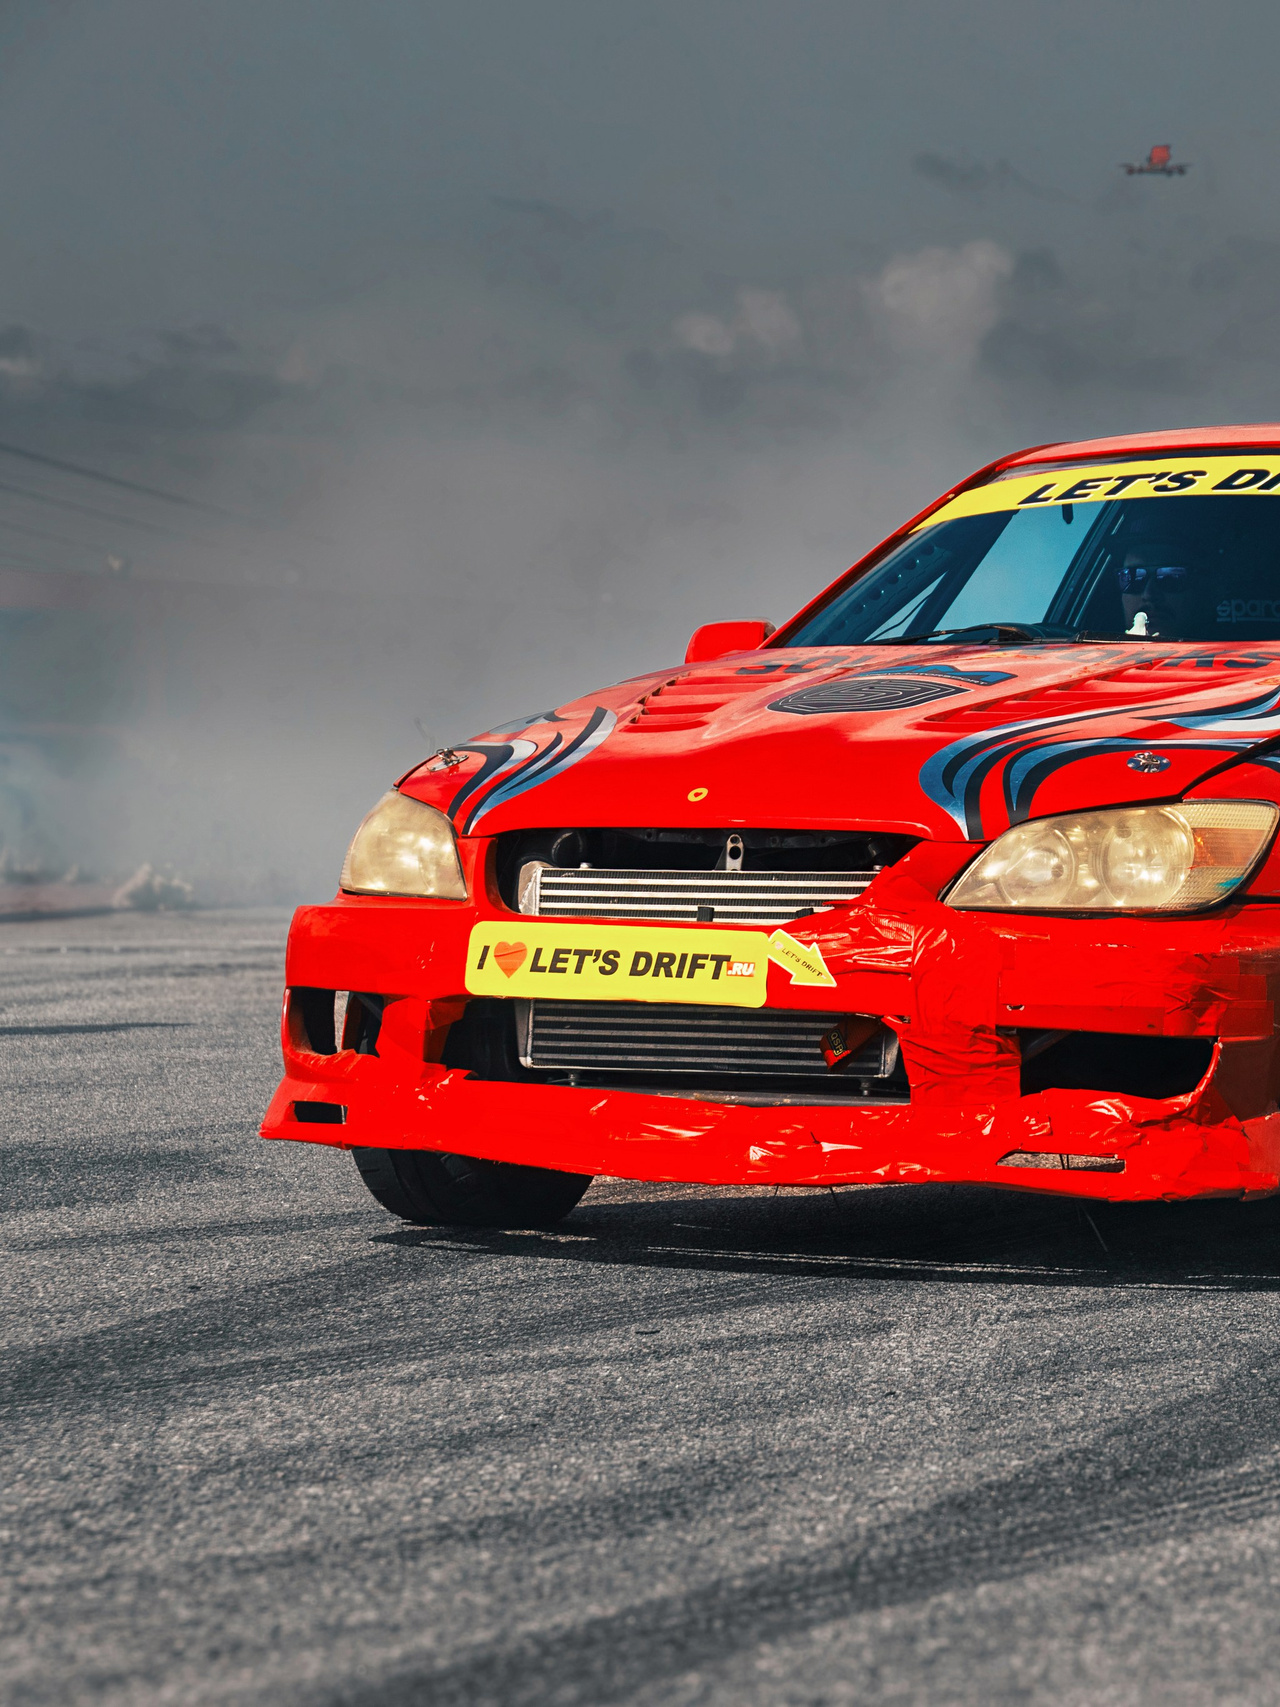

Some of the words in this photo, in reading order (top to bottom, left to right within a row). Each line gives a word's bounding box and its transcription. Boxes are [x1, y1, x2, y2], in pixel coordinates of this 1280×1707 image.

[1018, 468, 1208, 505] LET'S
[477, 945, 490, 970] I
[529, 947, 620, 976] LET'S
[781, 948, 801, 963] LET'S
